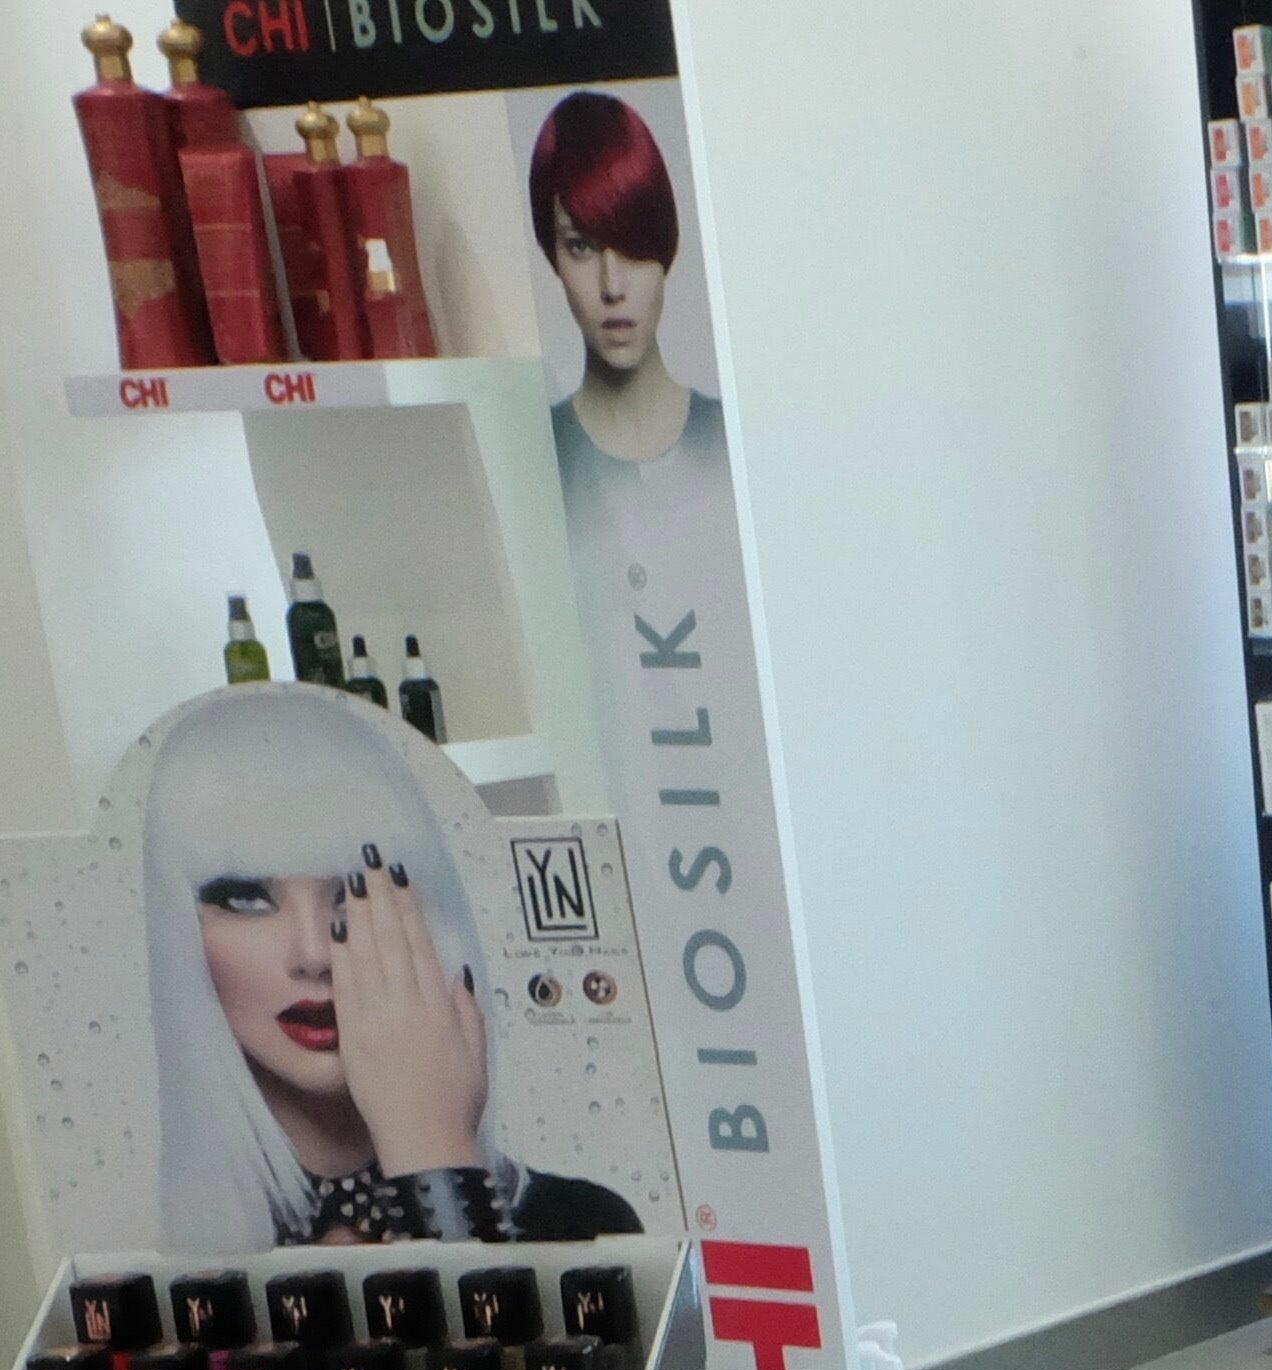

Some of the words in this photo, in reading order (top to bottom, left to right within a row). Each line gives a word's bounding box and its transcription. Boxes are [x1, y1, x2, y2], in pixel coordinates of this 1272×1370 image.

[222, 0, 310, 56] CHI
[119, 377, 169, 409] CHI
[264, 372, 316, 405] CHI
[634, 608, 770, 1153] BIOSILK
